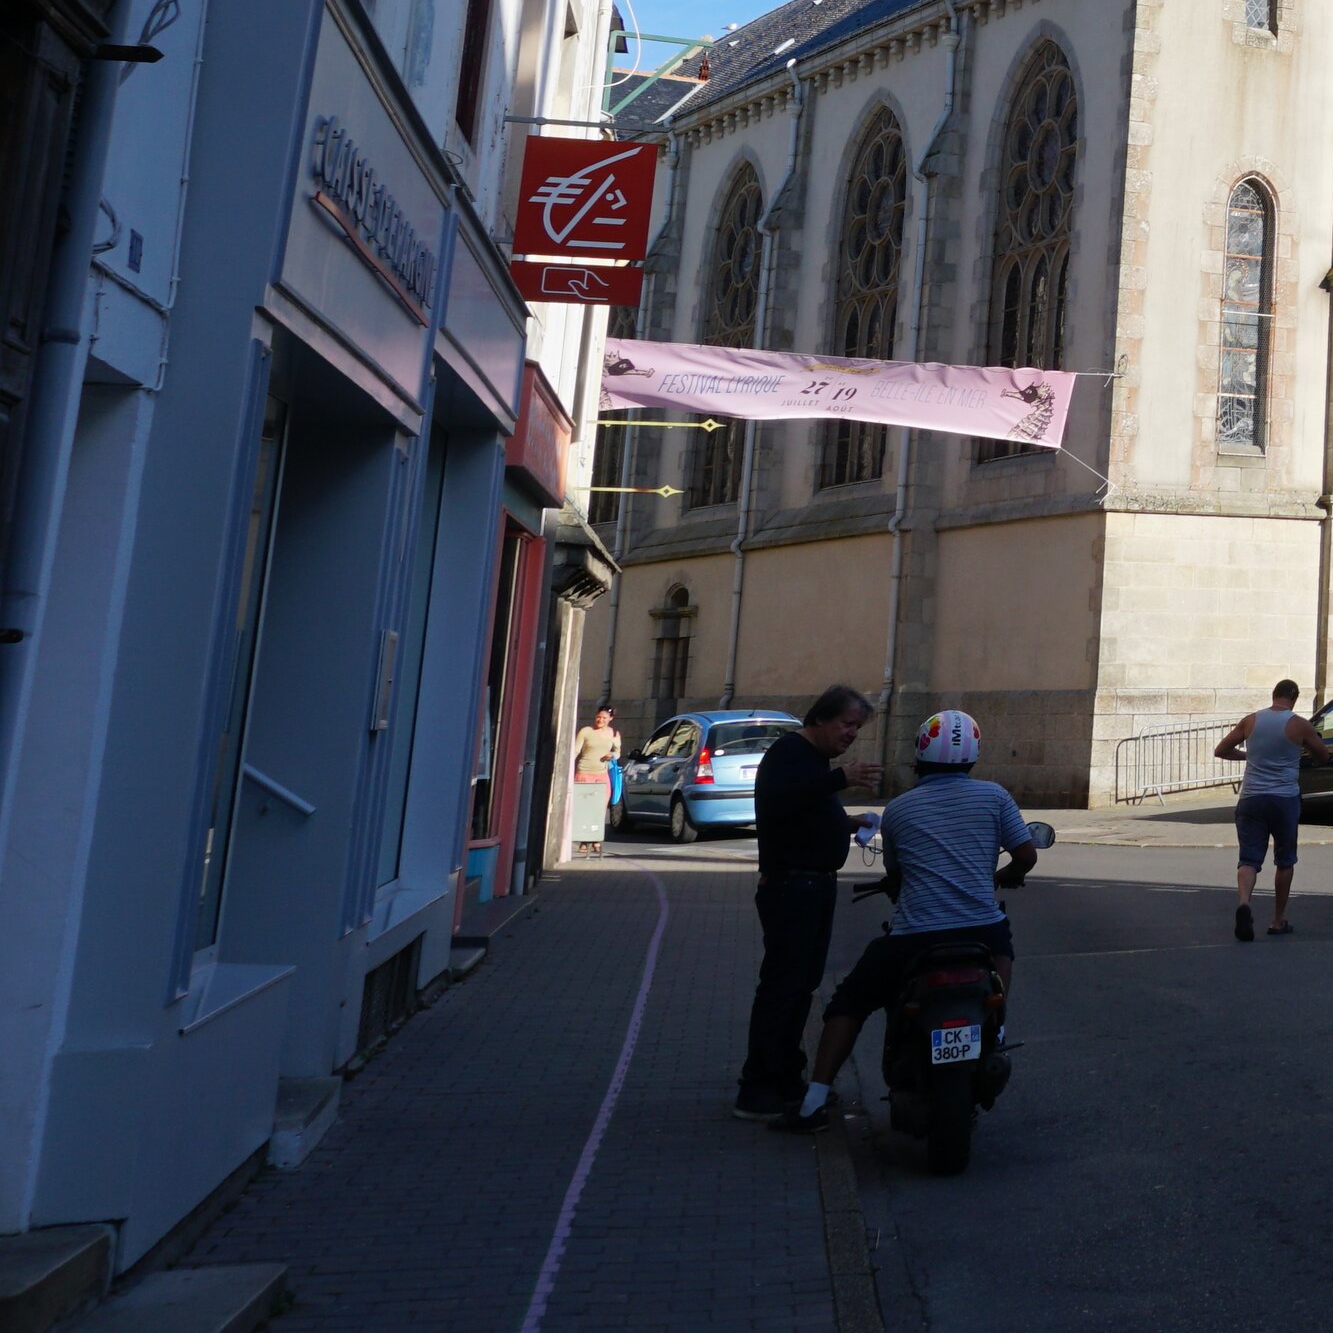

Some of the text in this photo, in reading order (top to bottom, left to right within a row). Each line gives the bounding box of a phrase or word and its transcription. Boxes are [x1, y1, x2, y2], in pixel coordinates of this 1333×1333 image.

[658, 374, 786, 395] FESTIVAL LYRIQUE
[801, 381, 829, 394] 27
[832, 387, 858, 401] 19
[936, 386, 954, 405] EN
[958, 388, 989, 409] MER
[781, 399, 820, 407] JUILLET
[945, 1030, 962, 1044] CK
